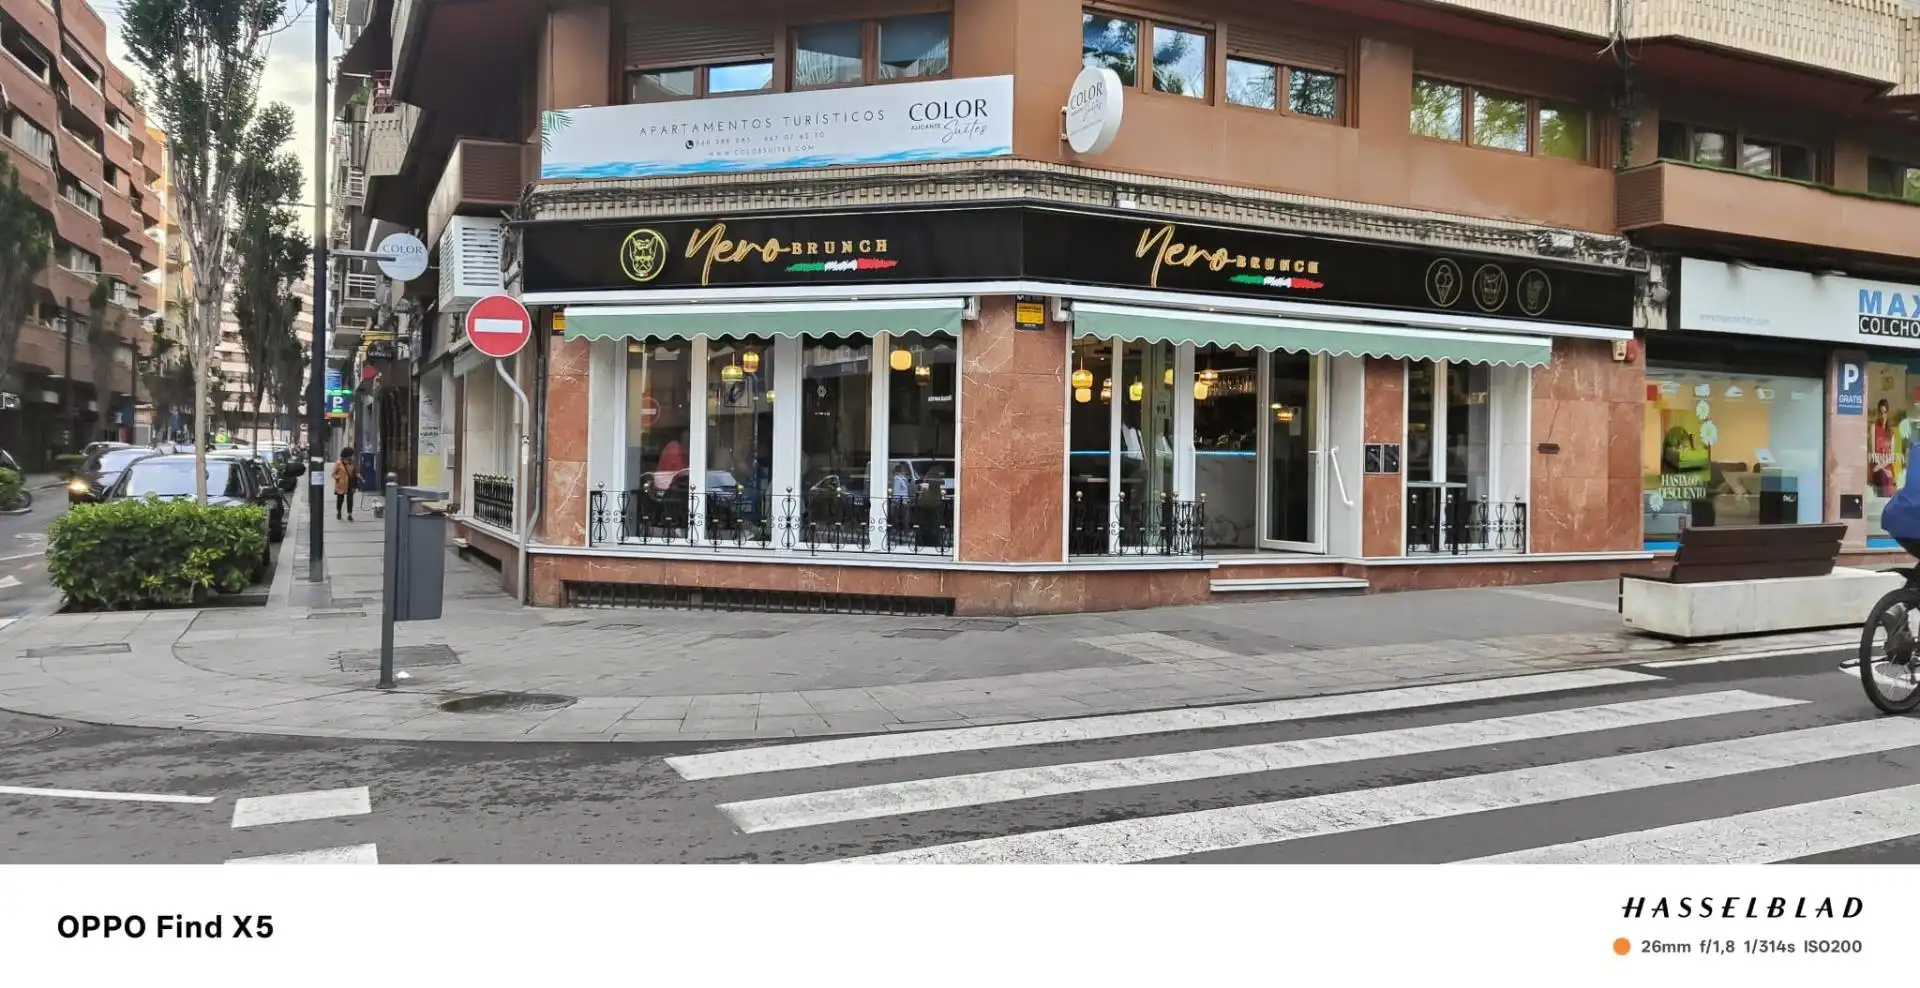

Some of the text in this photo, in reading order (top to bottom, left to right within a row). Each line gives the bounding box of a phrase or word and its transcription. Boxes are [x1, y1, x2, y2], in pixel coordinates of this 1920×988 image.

[1070, 82, 1103, 110] COLOR
[908, 98, 988, 122] COLOR
[639, 109, 885, 137] APARTAMENTOS TURÍSTICOS
[910, 123, 941, 131] ALICANTE
[941, 118, 988, 144] Suites
[382, 243, 423, 255] COLOR
[791, 239, 888, 256] BRUNCH
[1236, 255, 1320, 274] BRUNCH
[1859, 316, 1920, 337] COLCHO
[1843, 363, 1859, 391] P
[1838, 394, 1863, 405] GRATIS
